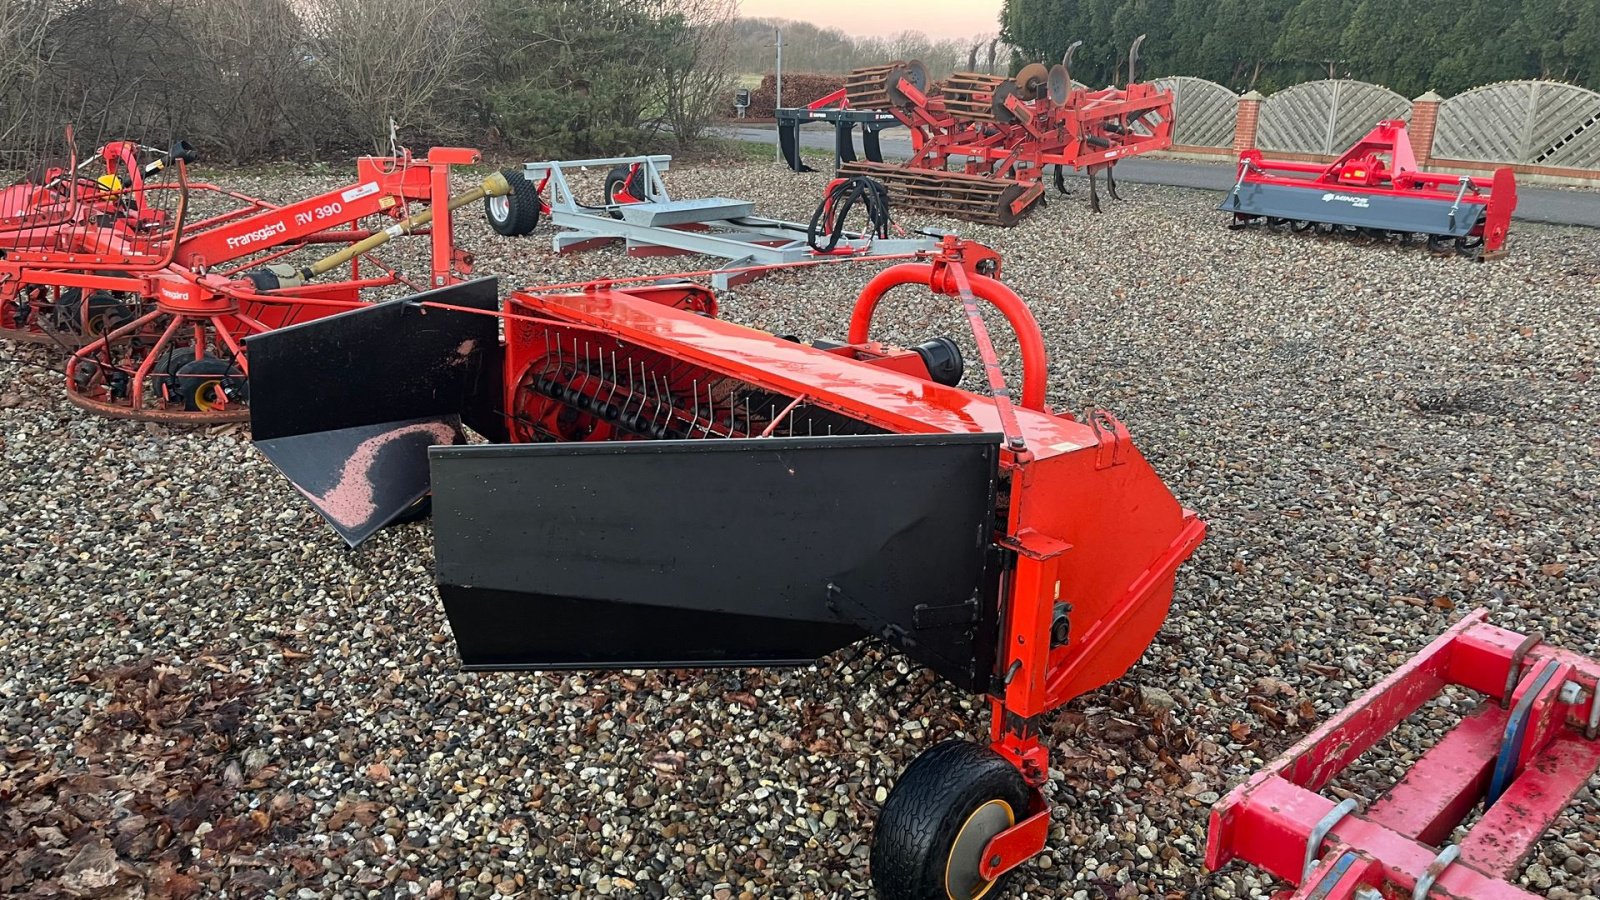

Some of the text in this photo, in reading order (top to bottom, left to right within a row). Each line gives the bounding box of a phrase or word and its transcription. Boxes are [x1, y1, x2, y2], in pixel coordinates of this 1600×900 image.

[226, 202, 342, 249] Fransgård RV 390
